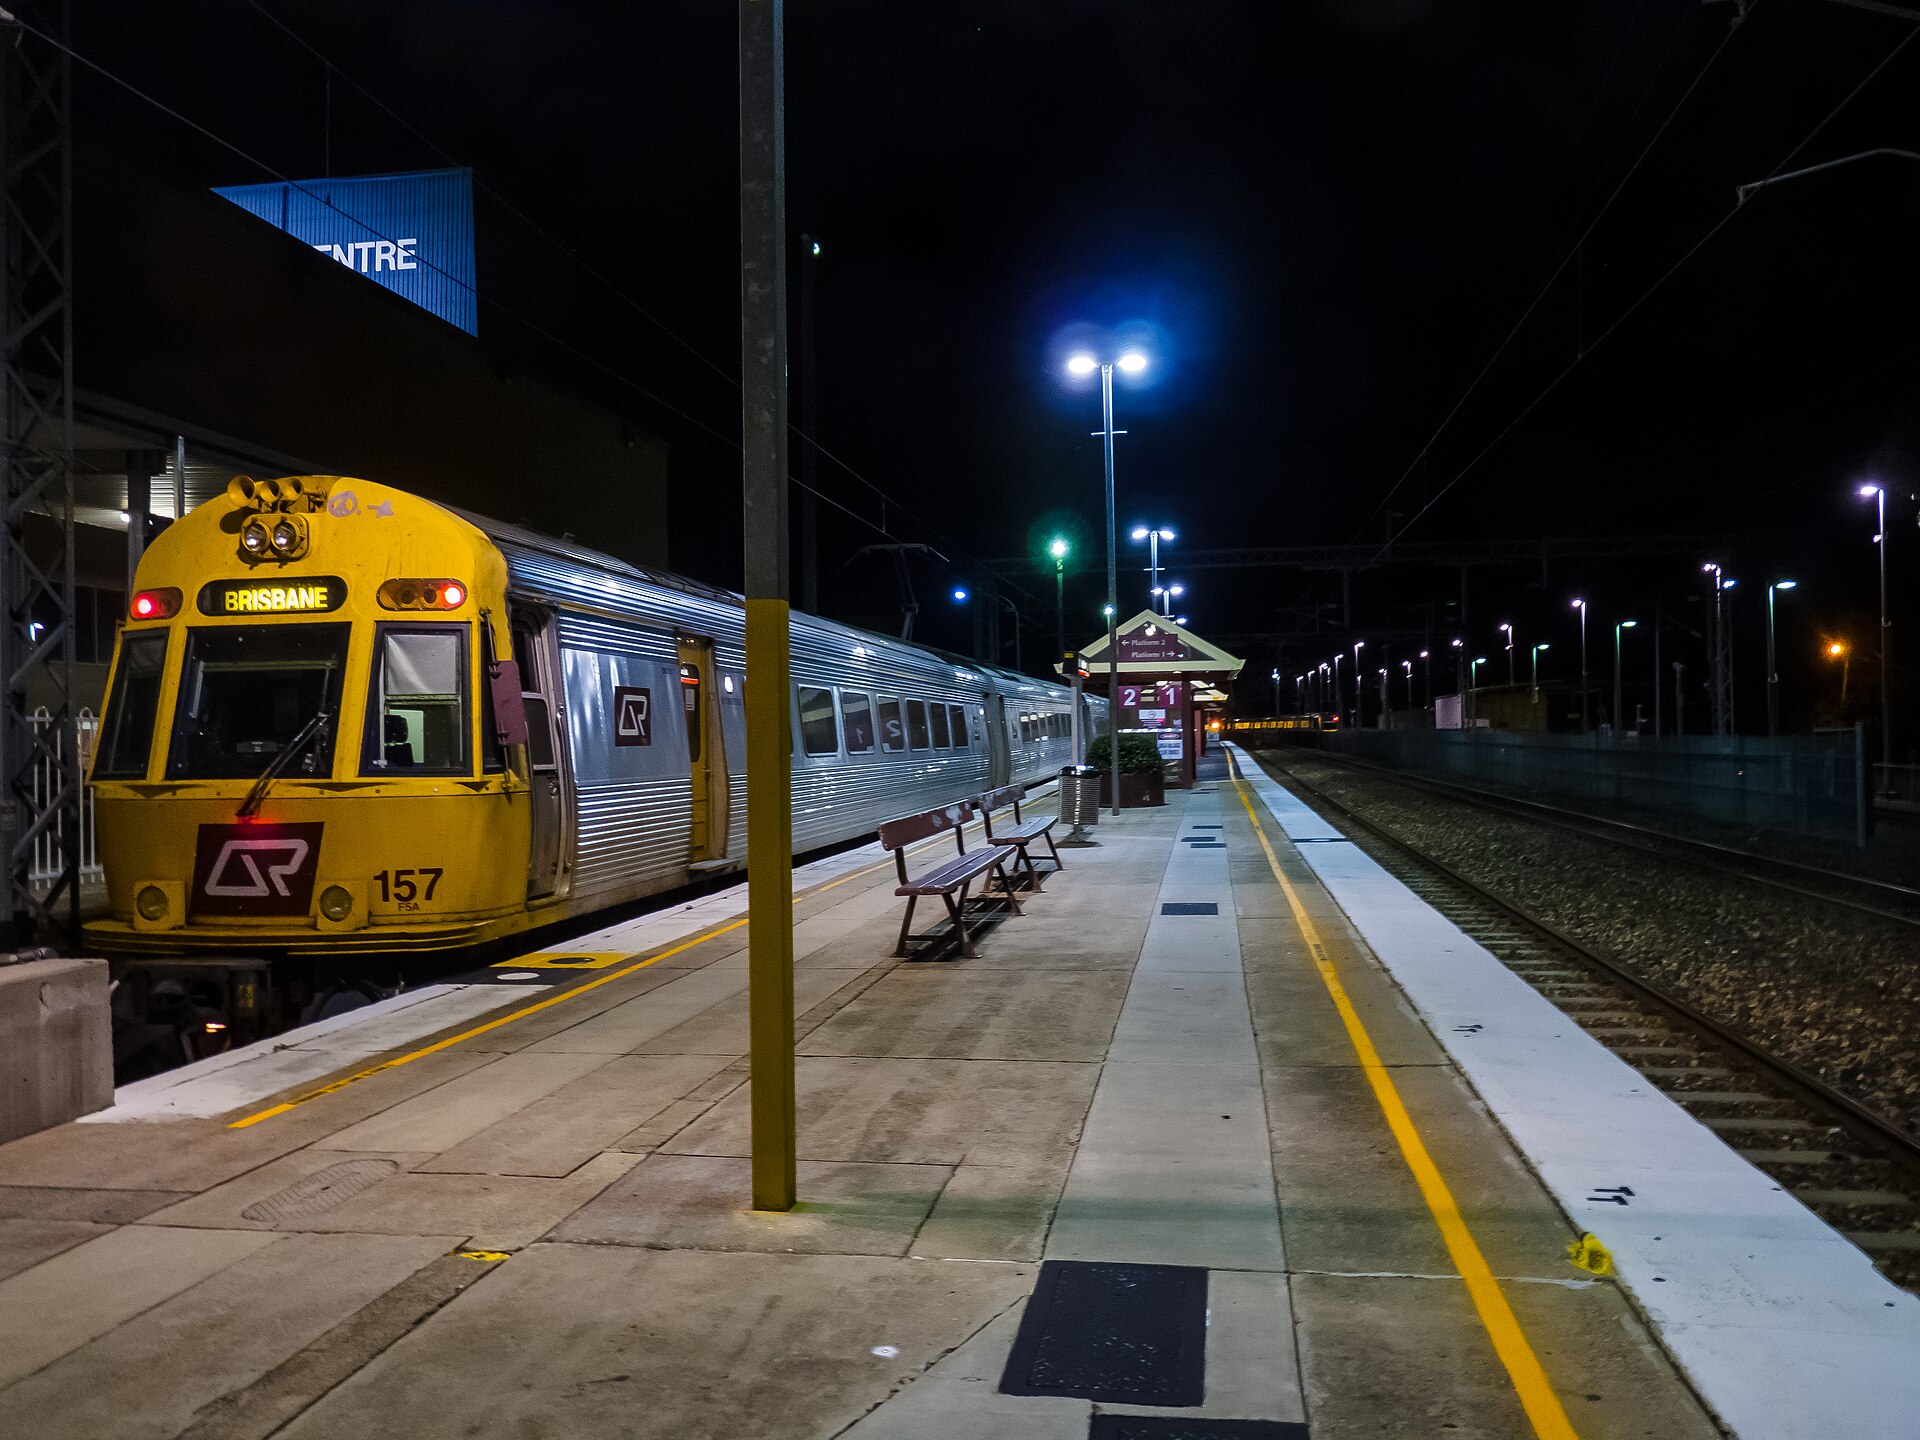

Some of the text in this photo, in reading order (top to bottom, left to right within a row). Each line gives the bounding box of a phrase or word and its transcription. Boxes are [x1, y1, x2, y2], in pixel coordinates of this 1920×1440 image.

[225, 586, 329, 611] BRISBANE
[1123, 688, 1136, 706] 2
[1165, 687, 1175, 705] 1
[204, 838, 309, 897] QR
[373, 867, 444, 902] 157
